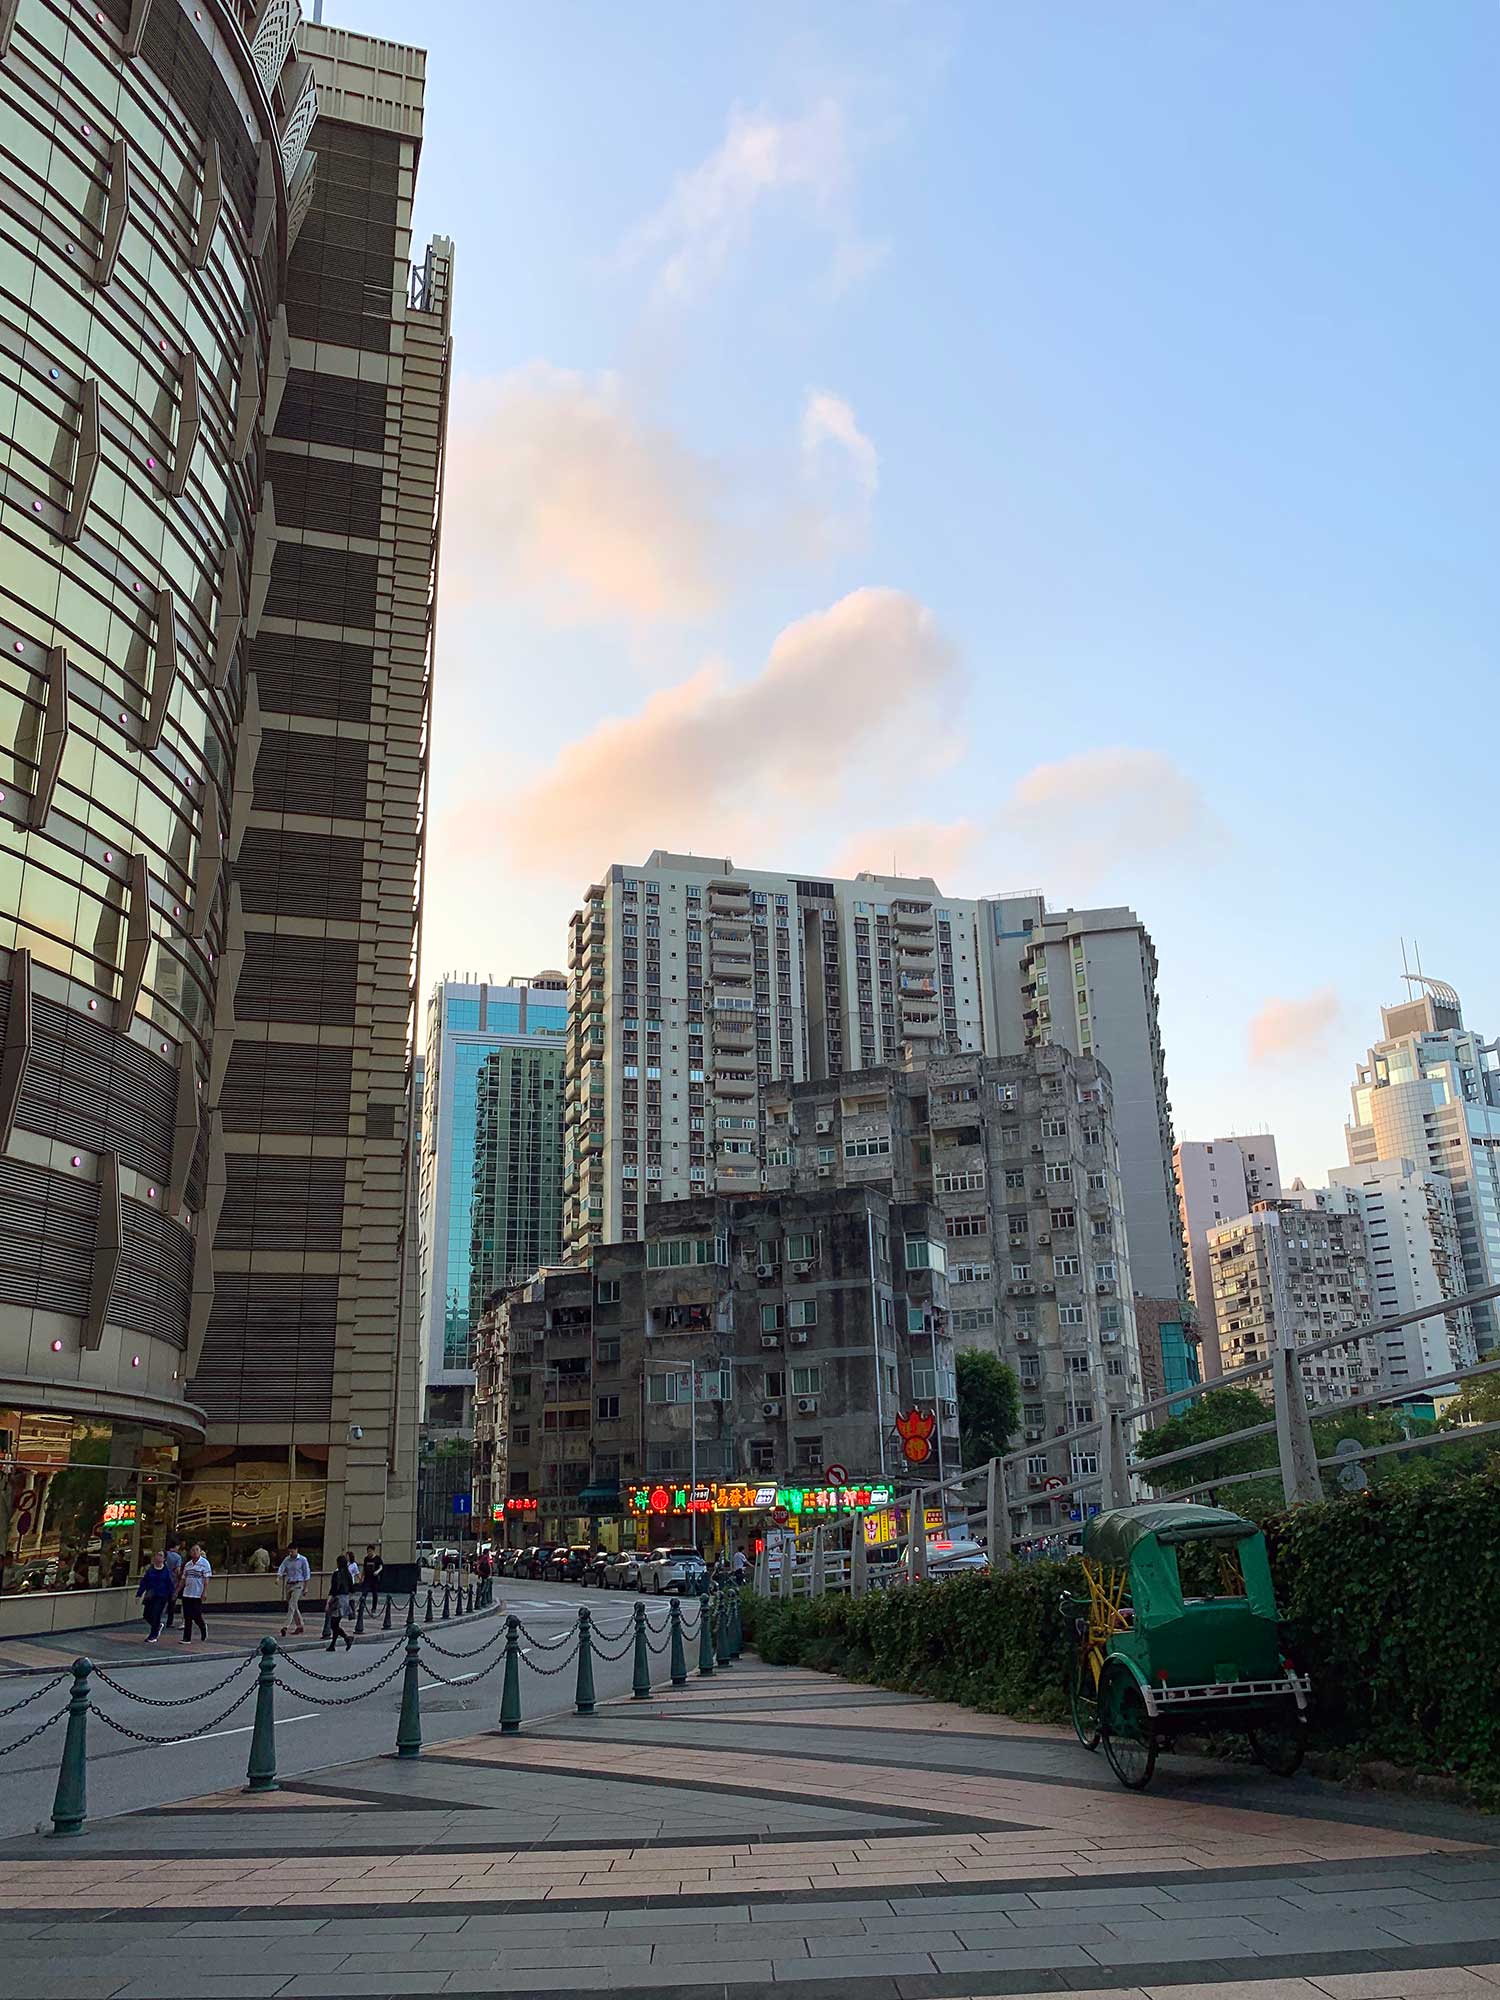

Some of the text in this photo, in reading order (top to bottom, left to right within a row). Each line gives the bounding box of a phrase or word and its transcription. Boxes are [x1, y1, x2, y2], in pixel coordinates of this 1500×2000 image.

[717, 1488, 756, 1507] 易發押
[774, 1510, 788, 1520] STOP
